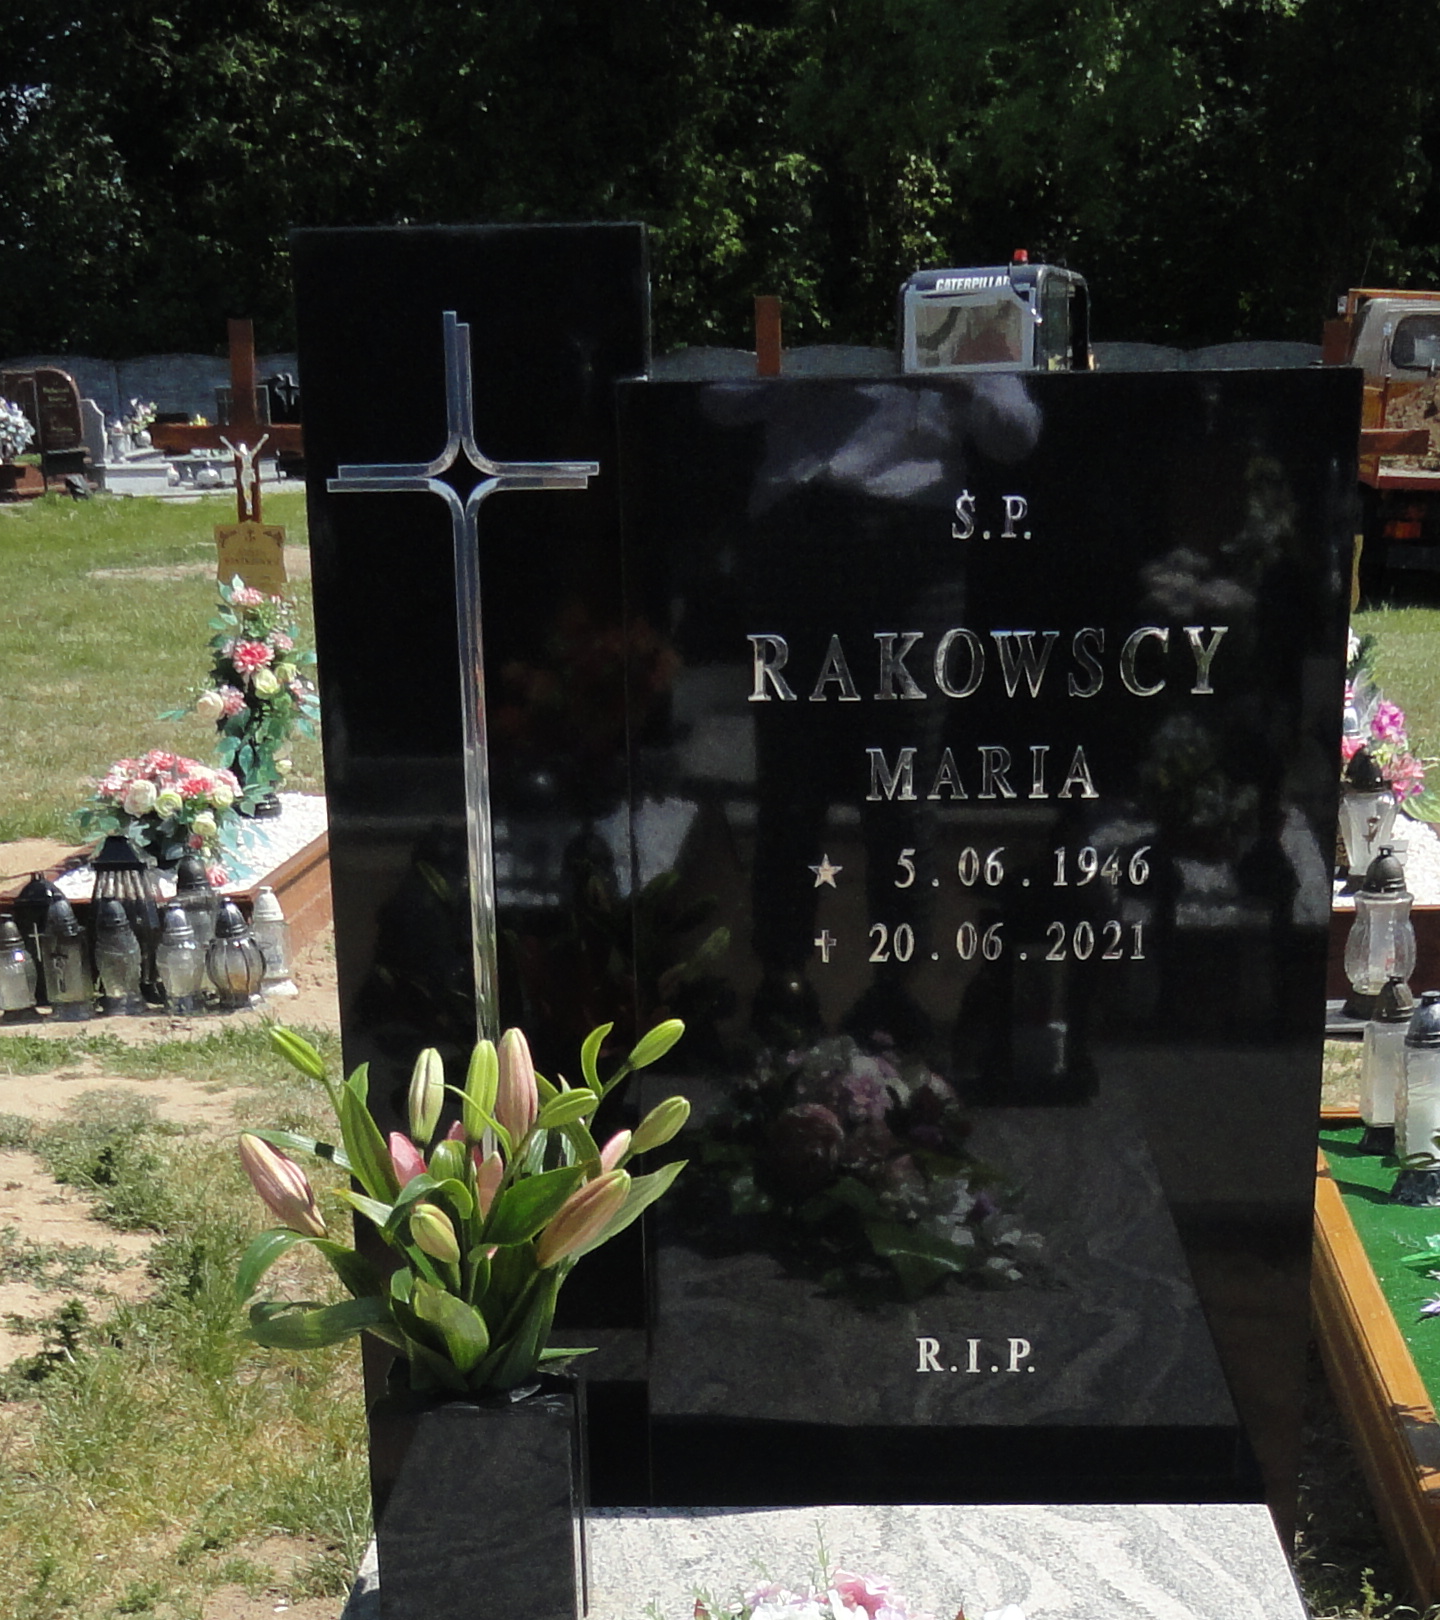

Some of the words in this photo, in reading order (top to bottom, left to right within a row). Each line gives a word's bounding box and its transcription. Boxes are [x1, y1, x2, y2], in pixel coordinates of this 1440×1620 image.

[746, 625, 1229, 702] RAKOWSCY
[865, 745, 1100, 801] MARIA
[1052, 845, 1152, 887] 1946
[1044, 919, 1147, 961] 2021
[915, 1336, 1037, 1374] R.I.P.
